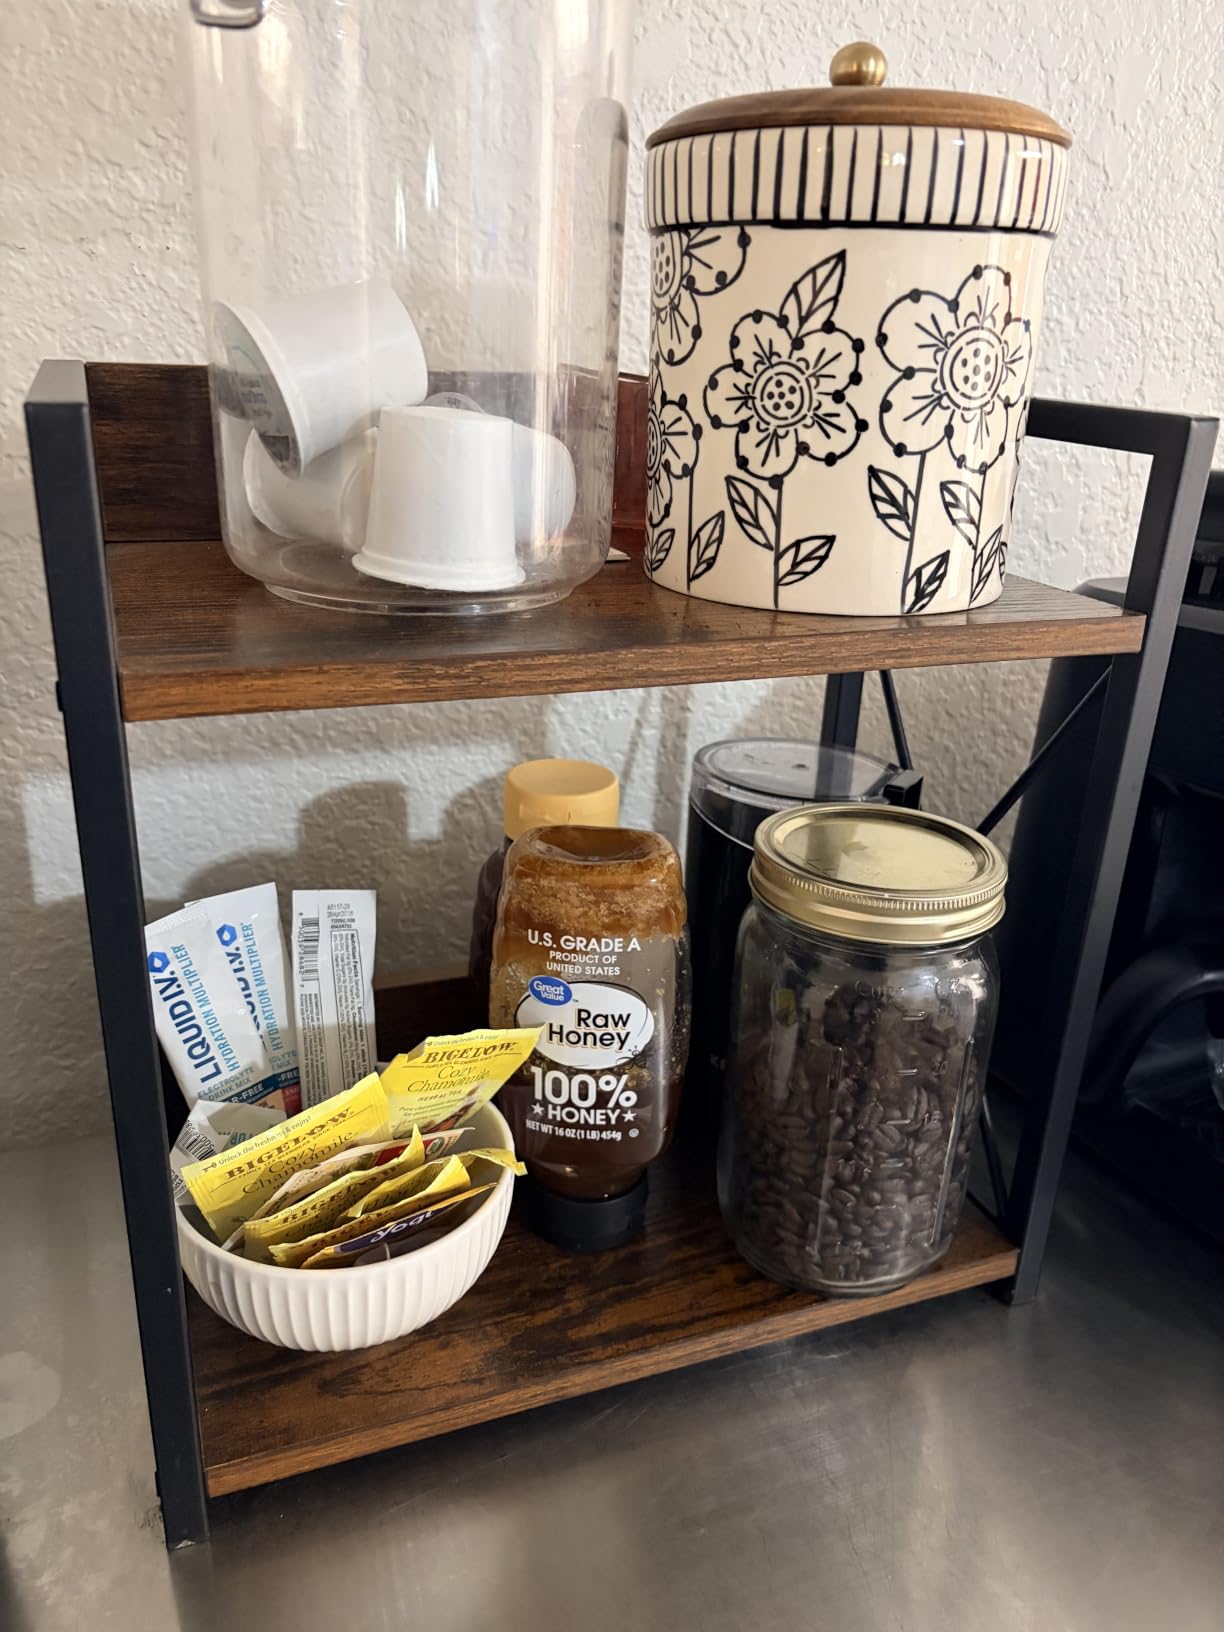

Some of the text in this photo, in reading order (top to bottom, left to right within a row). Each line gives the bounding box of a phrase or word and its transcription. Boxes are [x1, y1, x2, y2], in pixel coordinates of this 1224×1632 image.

[527, 929, 641, 952] U.S. GRADE A
[546, 962, 621, 976] UNITED STATES
[550, 951, 617, 964] PRODUCT OF
[533, 980, 565, 1002] Great Value
[257, 989, 283, 1051] HYDRATION
[577, 1009, 632, 1028] Raw
[169, 1000, 223, 1083] LIQUID
[202, 1008, 241, 1072] HYDRATION
[548, 1022, 631, 1051] Honey
[423, 1042, 518, 1064] BIGELOW
[197, 1065, 255, 1098] ELECTROLYTE
[438, 1065, 477, 1080] Cozy
[208, 1083, 234, 1101] DRINK
[235, 1077, 251, 1089] MIX
[231, 1083, 265, 1103] R-FREE
[530, 1065, 638, 1108] 100%
[547, 1105, 621, 1125] HONEY
[218, 1151, 242, 1165] Unlock
[243, 1145, 254, 1154] the
[292, 1115, 312, 1130] enjoy!
[225, 1106, 353, 1178] BIGELOW
[526, 1119, 540, 1131] NET
[540, 1123, 553, 1134] WT
[554, 1126, 565, 1136] 16
[565, 1128, 576, 1138] OZ
[601, 1131, 622, 1141] 454g
[243, 1132, 353, 1193] Chamomile
[269, 1143, 317, 1173] Cozy
